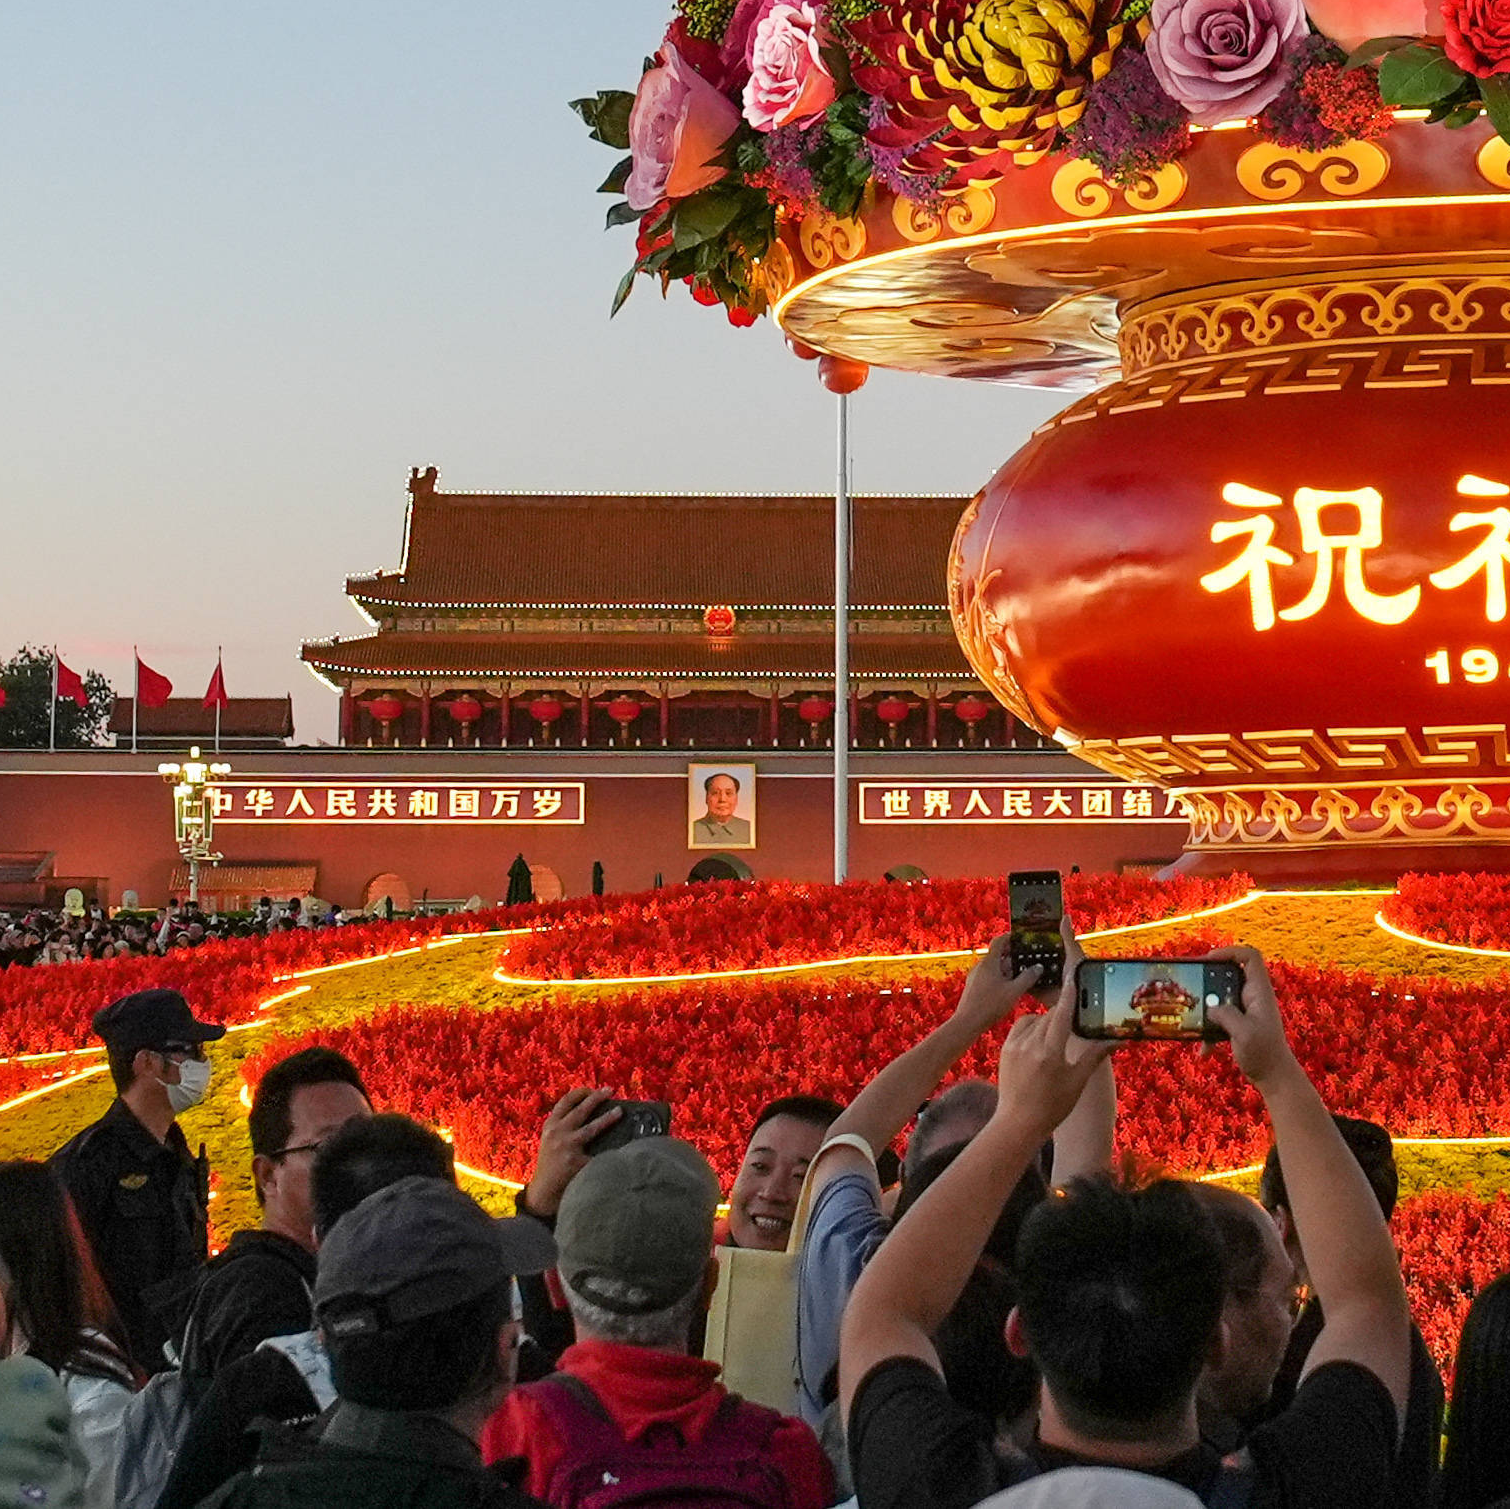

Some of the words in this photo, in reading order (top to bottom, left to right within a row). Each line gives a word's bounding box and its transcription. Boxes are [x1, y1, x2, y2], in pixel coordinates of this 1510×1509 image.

[205, 788, 562, 818] 中华人民共和国万岁
